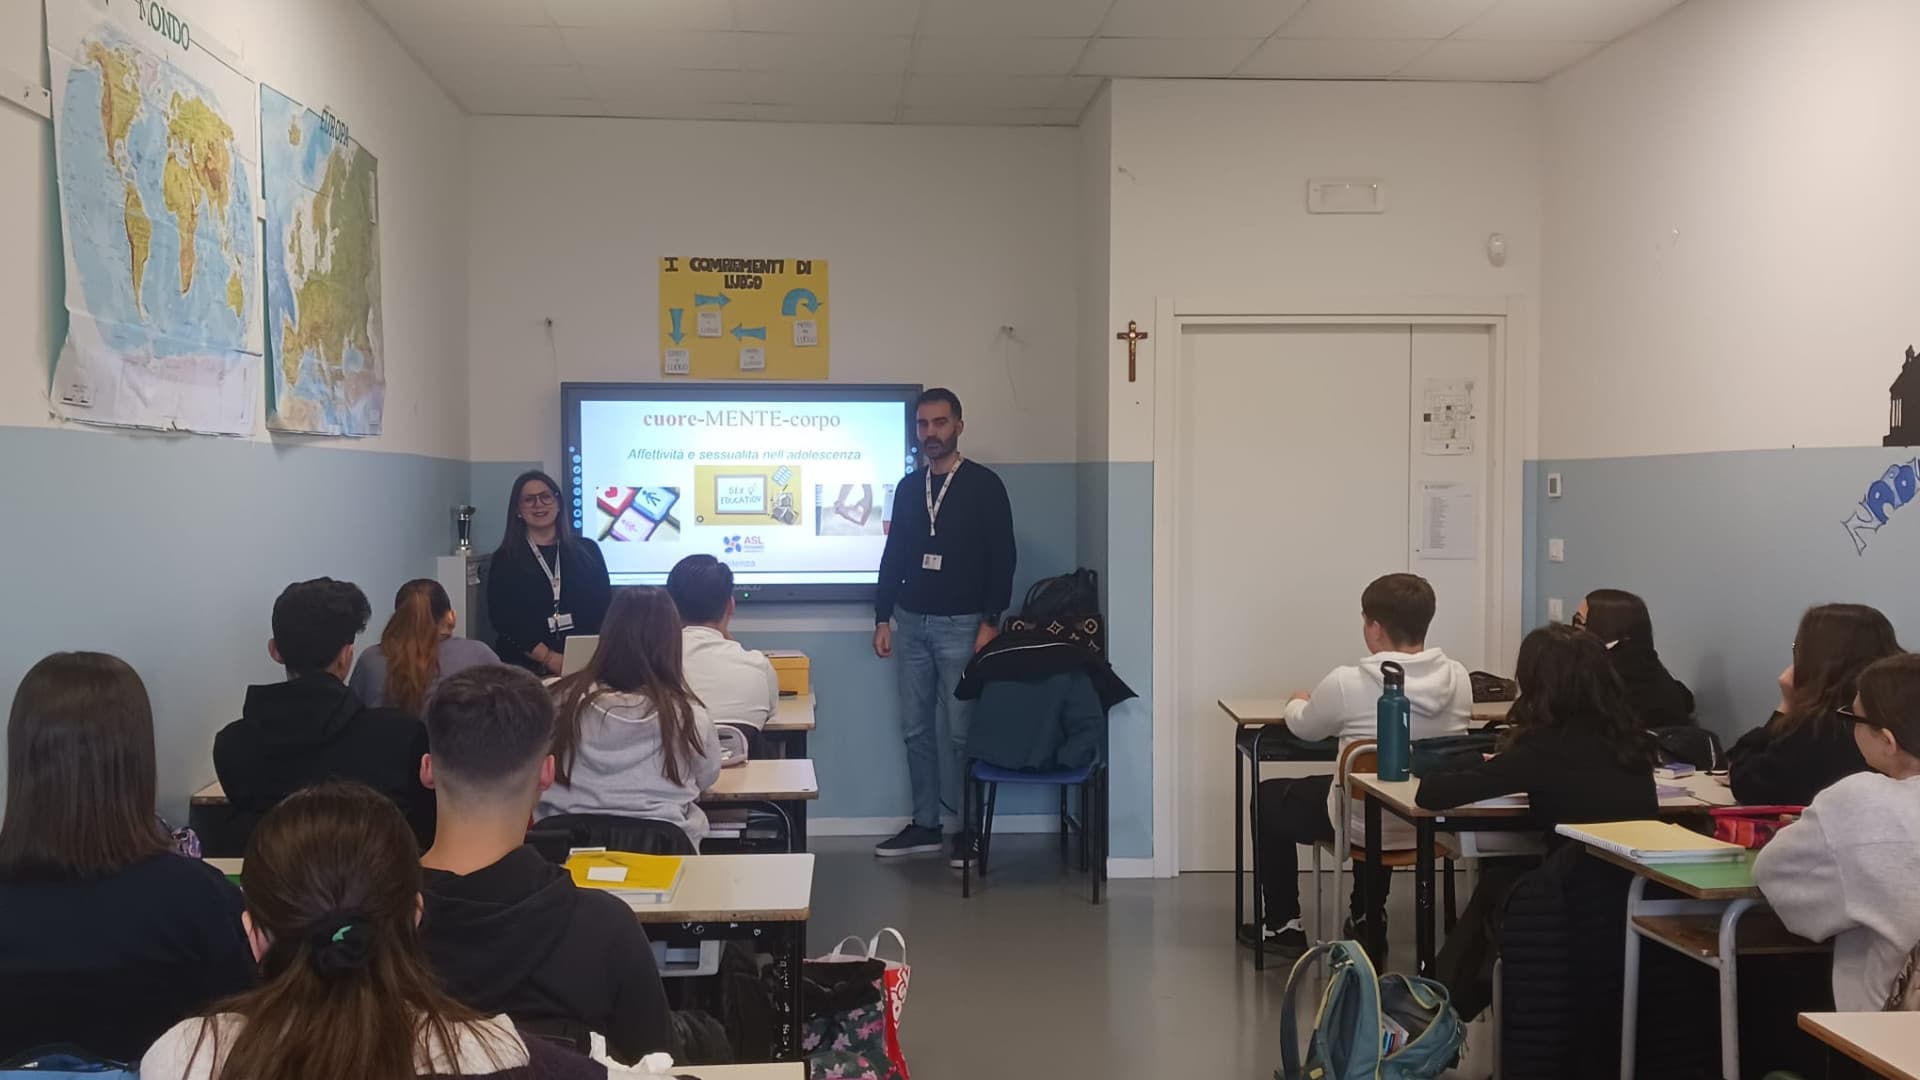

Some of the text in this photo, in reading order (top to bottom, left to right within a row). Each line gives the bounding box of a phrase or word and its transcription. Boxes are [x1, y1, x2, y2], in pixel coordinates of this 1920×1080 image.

[134, 0, 190, 51] MONDO
[320, 108, 349, 148] EUROPA
[664, 256, 679, 272] I
[796, 260, 812, 275] DI
[643, 409, 841, 432] cuore-MENTE-corpo
[627, 447, 685, 461] Affettività
[687, 450, 695, 460] e
[699, 447, 759, 461] sessualità
[743, 535, 766, 545] ASL
